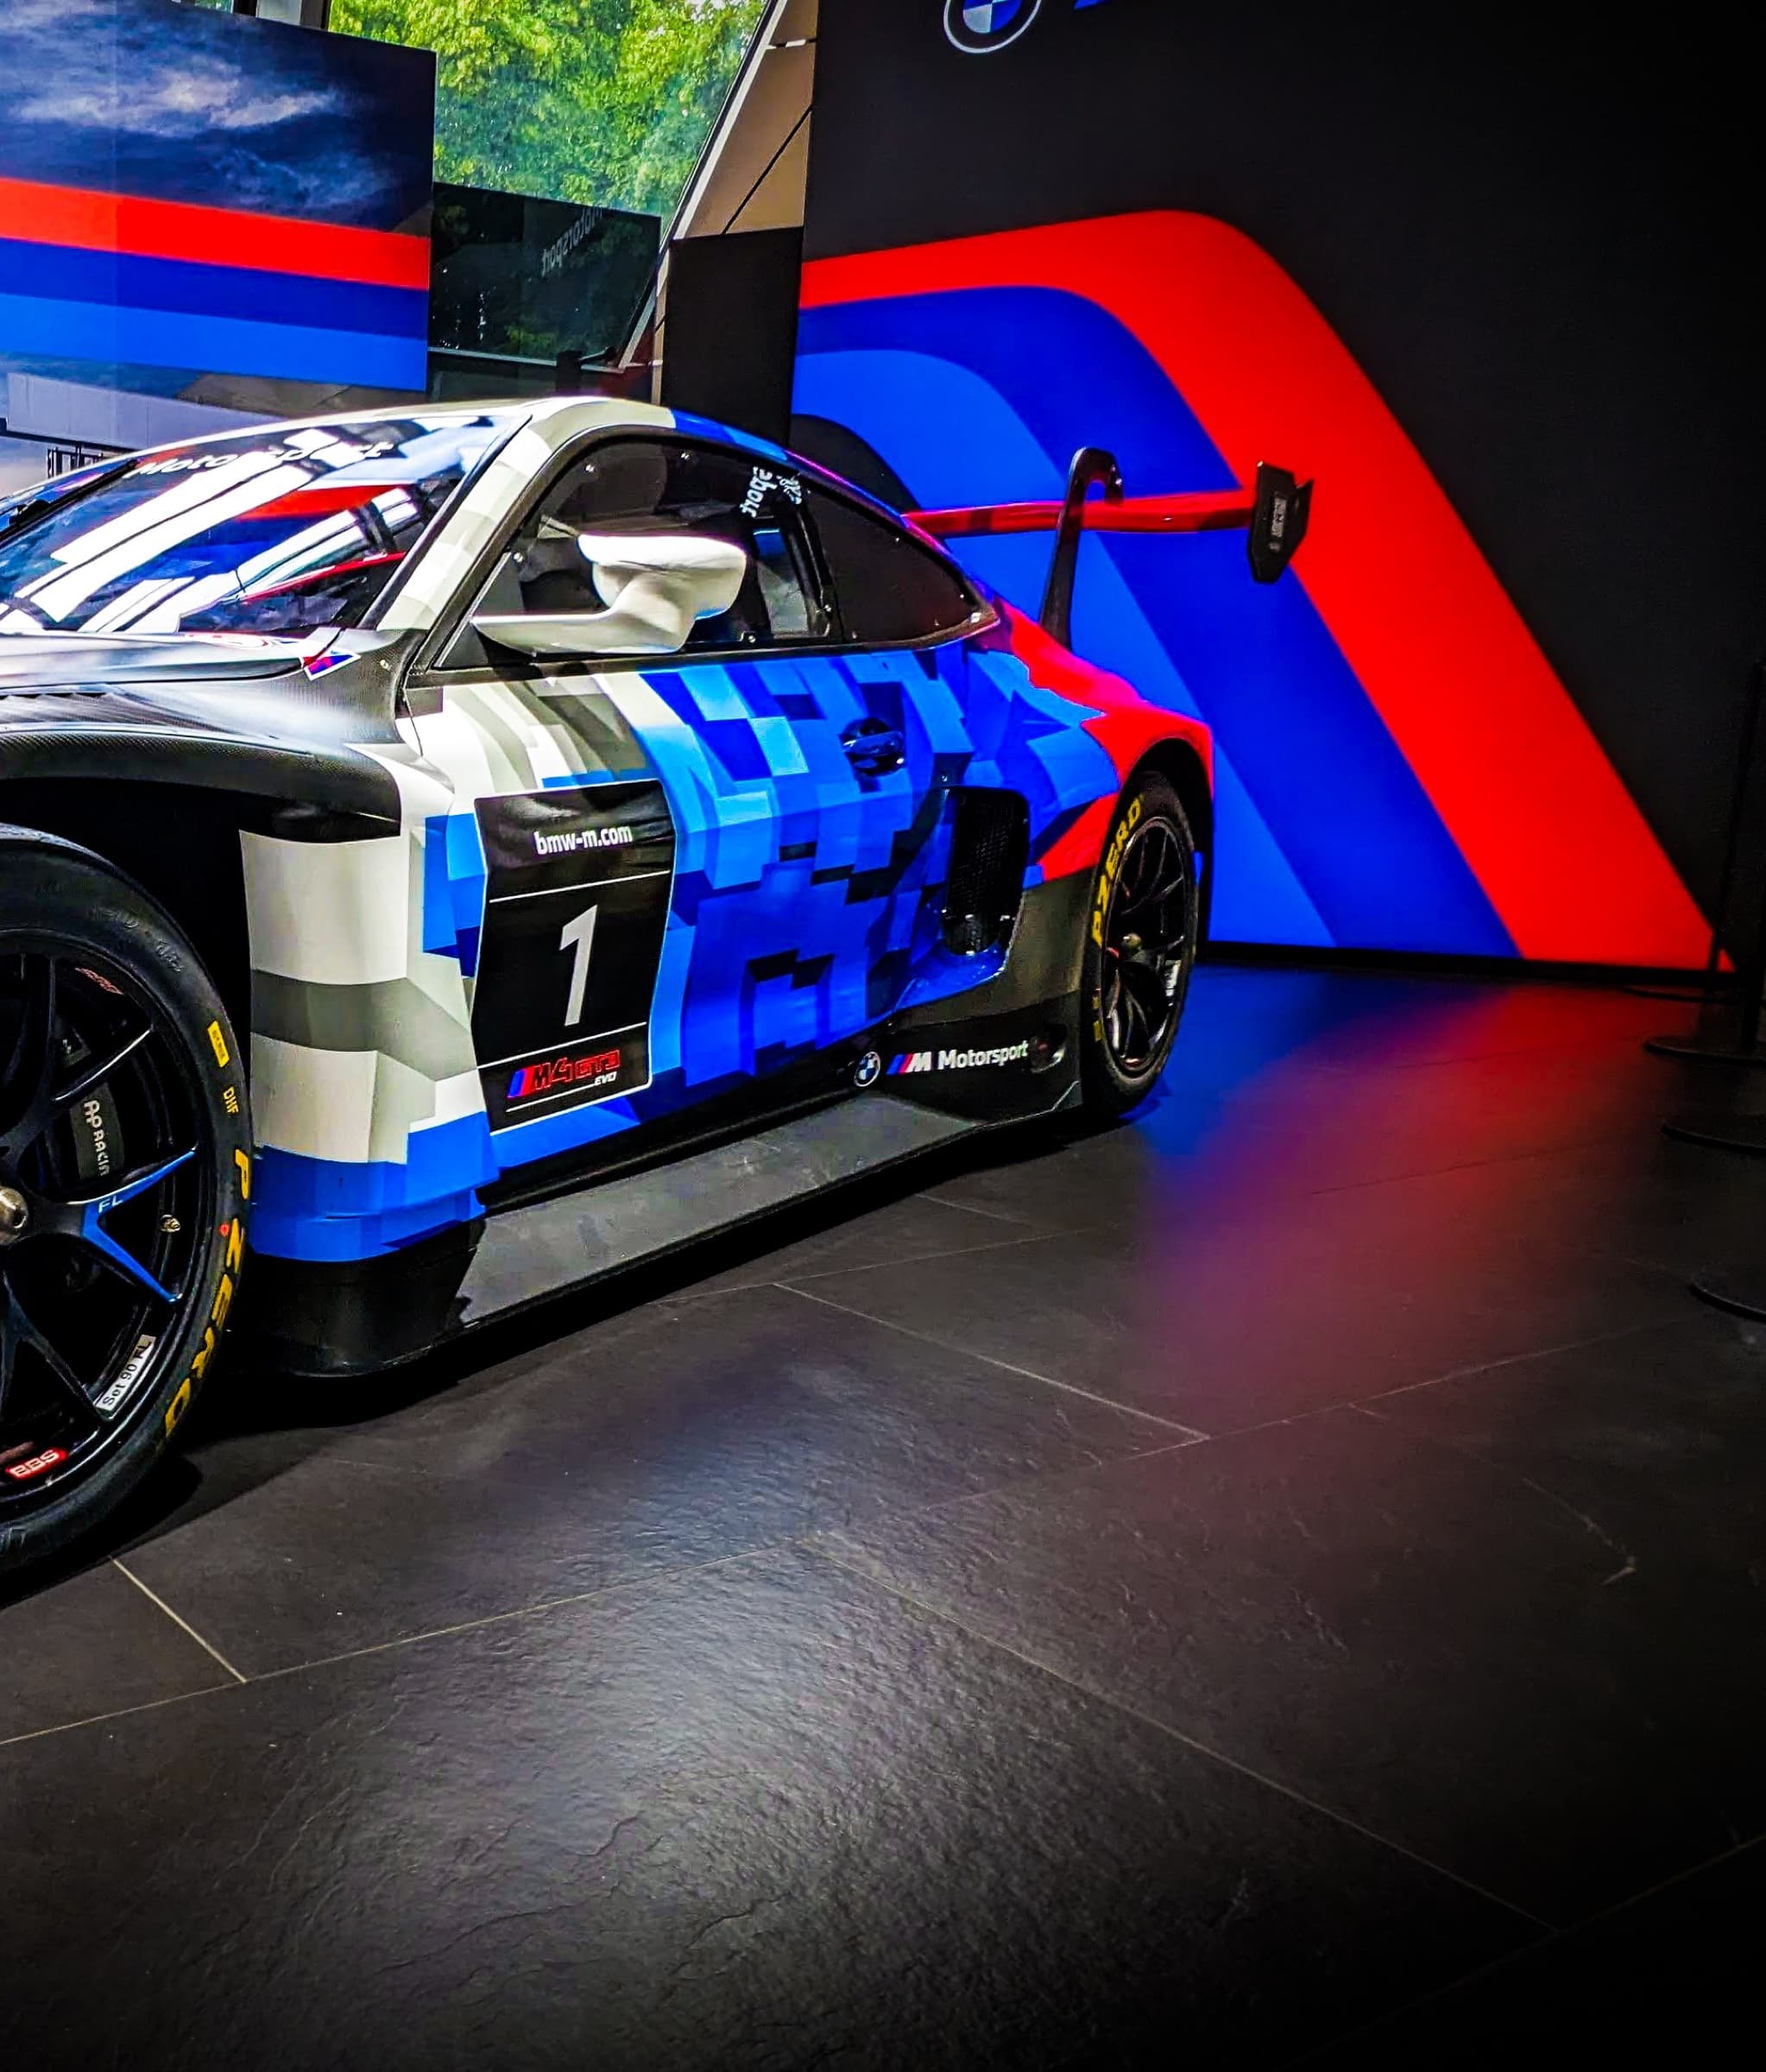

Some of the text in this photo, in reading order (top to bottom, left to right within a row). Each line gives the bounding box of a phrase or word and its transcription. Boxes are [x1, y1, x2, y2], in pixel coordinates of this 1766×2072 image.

[533, 826, 633, 855] bmw-m.com
[559, 905, 598, 1027] 1
[904, 1039, 1029, 1073] M Motorsport
[593, 1071, 617, 1086] EVO
[223, 1086, 239, 1114] DHF
[98, 1195, 123, 1214] FL
[102, 1341, 153, 1406] Set 90 FL
[9, 1450, 60, 1478] BBS
